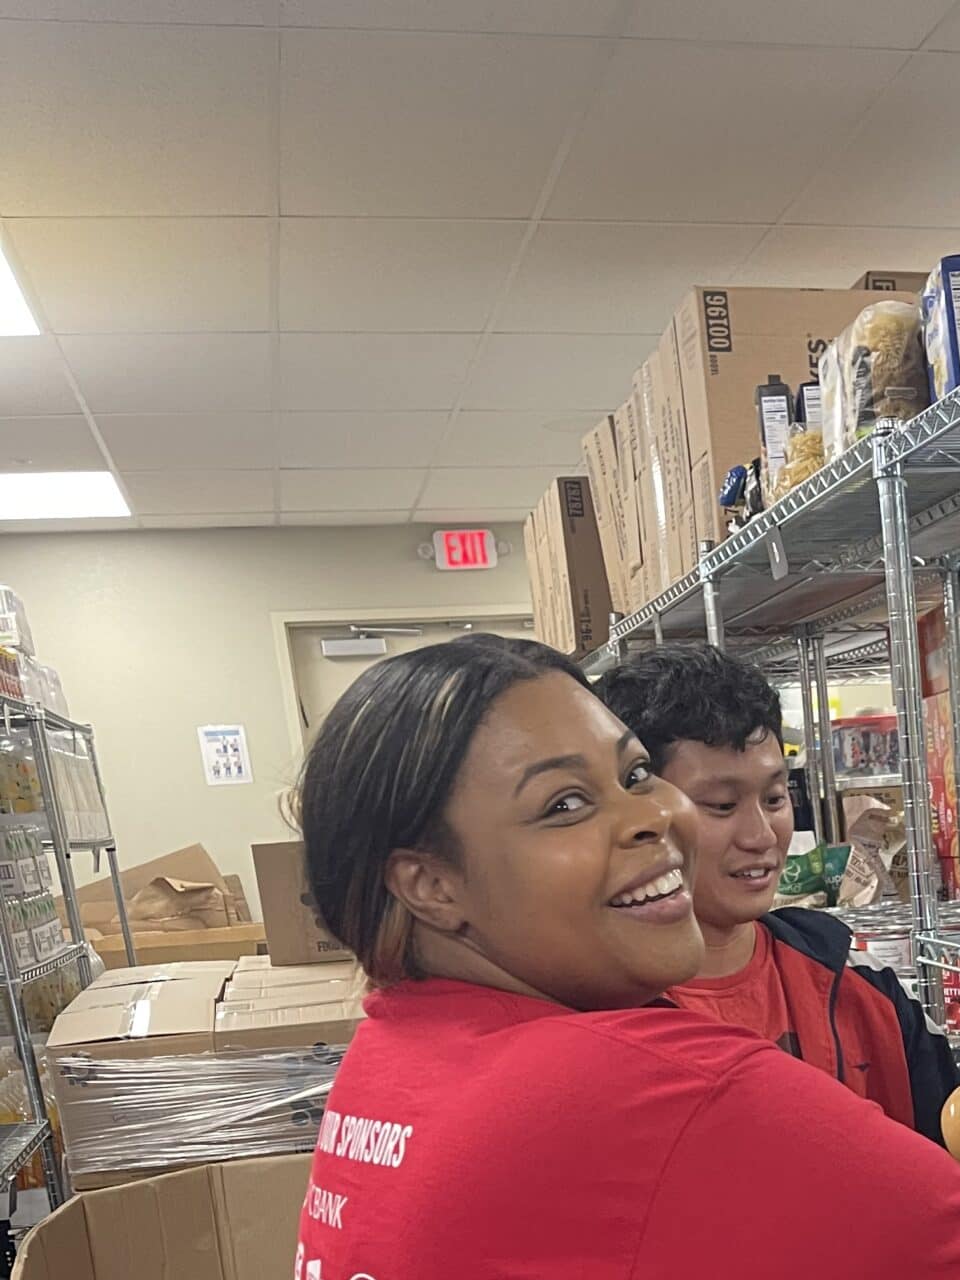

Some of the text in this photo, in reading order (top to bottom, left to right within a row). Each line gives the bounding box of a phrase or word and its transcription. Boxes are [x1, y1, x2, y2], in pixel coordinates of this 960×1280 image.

[706, 294, 730, 349] 00196
[445, 531, 488, 566] EXIT
[336, 1114, 414, 1168] SPONSORS
